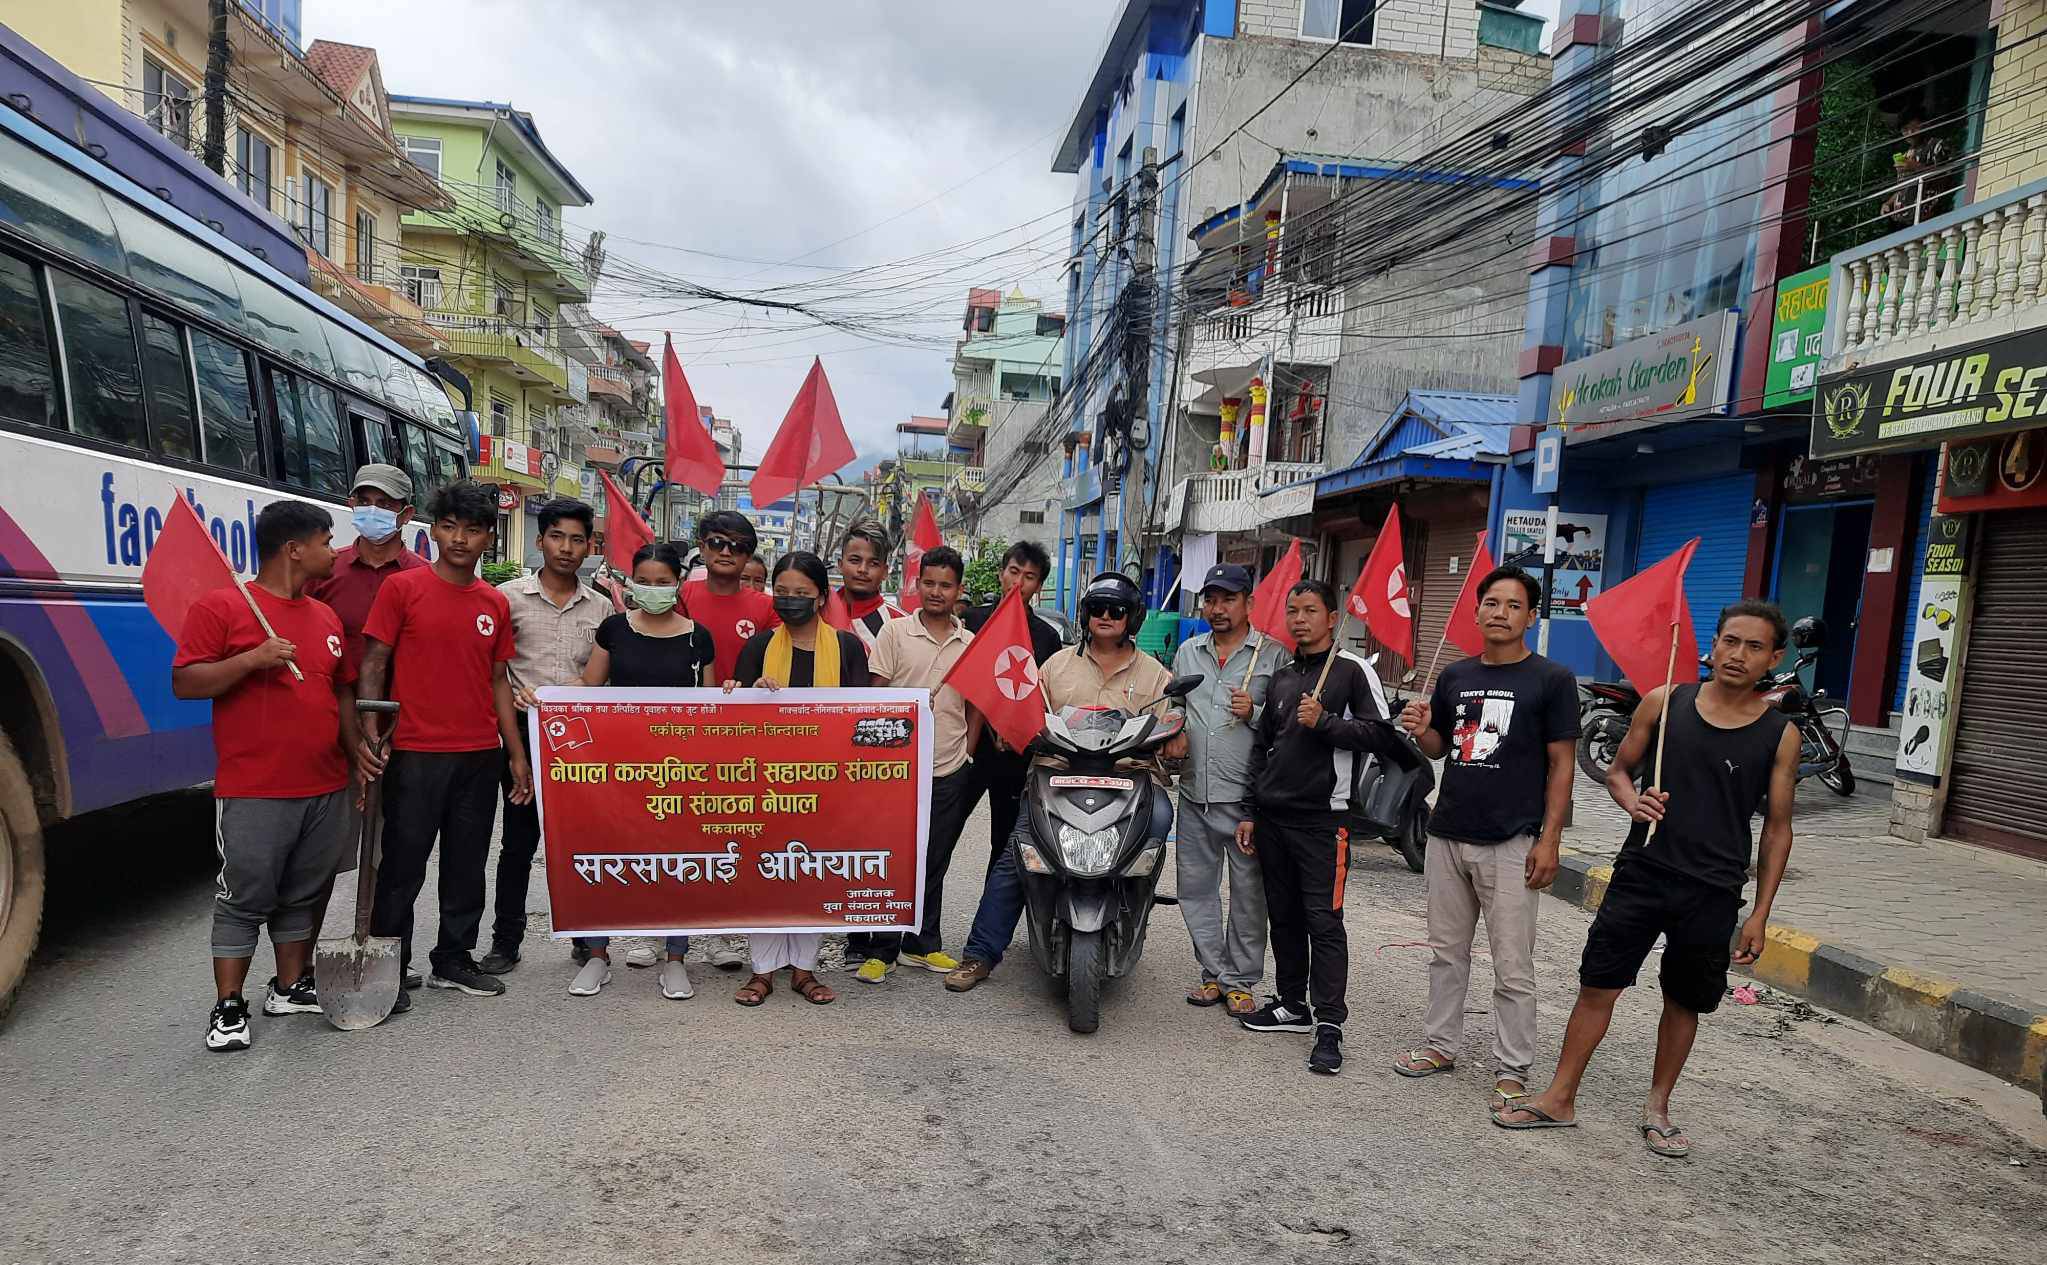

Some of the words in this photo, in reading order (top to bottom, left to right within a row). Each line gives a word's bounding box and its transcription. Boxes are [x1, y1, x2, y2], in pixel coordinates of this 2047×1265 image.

[1882, 353, 1990, 417] FOUR
[1985, 364, 2047, 423] SE
[1537, 438, 1558, 486] P
[1506, 515, 1547, 527] HETAUDA
[1926, 543, 1957, 557] FOUR
[1460, 690, 1485, 698] TOKYO
[1486, 689, 1515, 698] GHOUL
[649, 723, 695, 741] एकीकृत
[550, 756, 608, 784] नेपाल
[614, 756, 710, 789] कम्युनिष्ट
[716, 757, 757, 783] पार्टी
[763, 761, 838, 784] सहायक
[844, 758, 910, 782] संगठन
[646, 795, 683, 821] युवा
[689, 792, 755, 816] संगठन
[761, 788, 818, 815] नेपाल
[701, 823, 765, 839] मकवानपुर
[573, 842, 741, 886] सरसफाई
[757, 840, 892, 882] अभियान
[846, 888, 895, 899] आयोजक
[823, 903, 842, 914] युवा
[848, 901, 881, 911] संगठन
[885, 900, 912, 911] नेपाल
[845, 913, 897, 925] मकवानपुर
